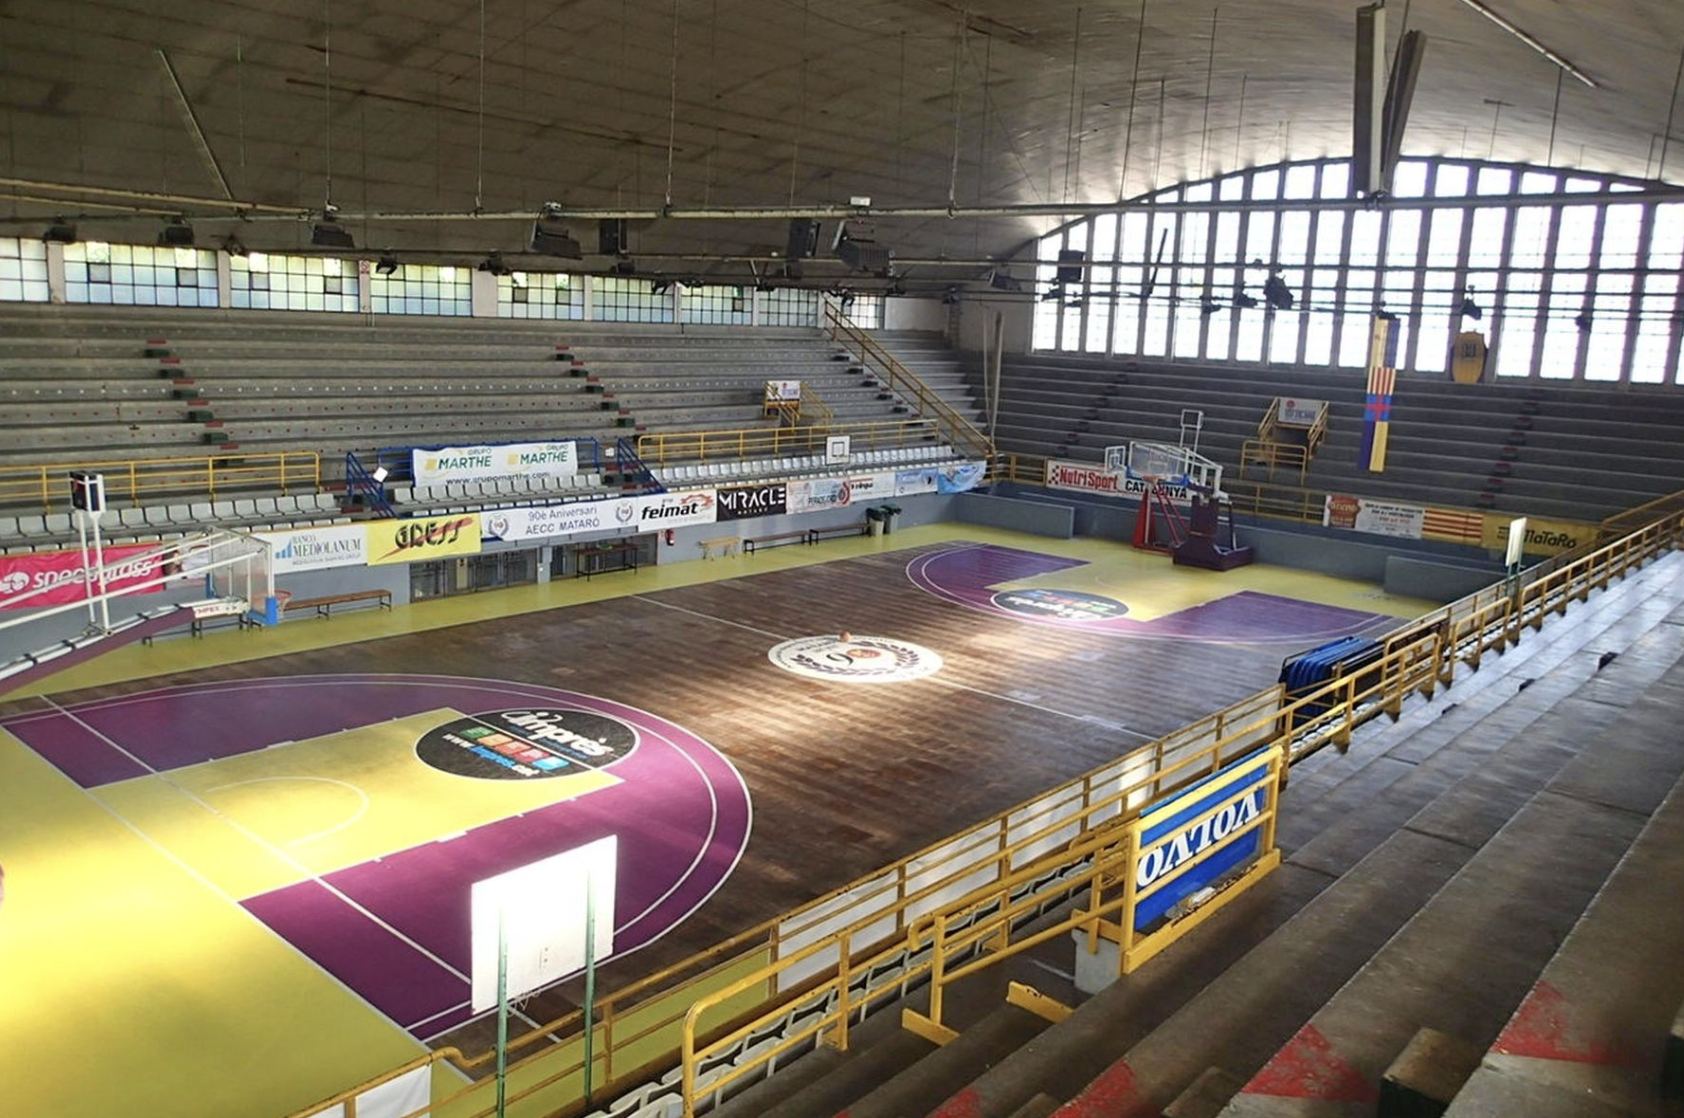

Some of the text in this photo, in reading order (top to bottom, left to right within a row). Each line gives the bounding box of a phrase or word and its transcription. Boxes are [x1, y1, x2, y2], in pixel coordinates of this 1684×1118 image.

[438, 455, 492, 470] MARTHE
[519, 451, 568, 465] MARTHE
[719, 487, 785, 510] MIRACLE
[549, 506, 598, 519] Aniversari
[641, 502, 699, 520] feimat
[525, 523, 555, 535] AECC
[293, 538, 361, 557] MEDIOLANUM
[1136, 792, 1260, 887] VOLVO
